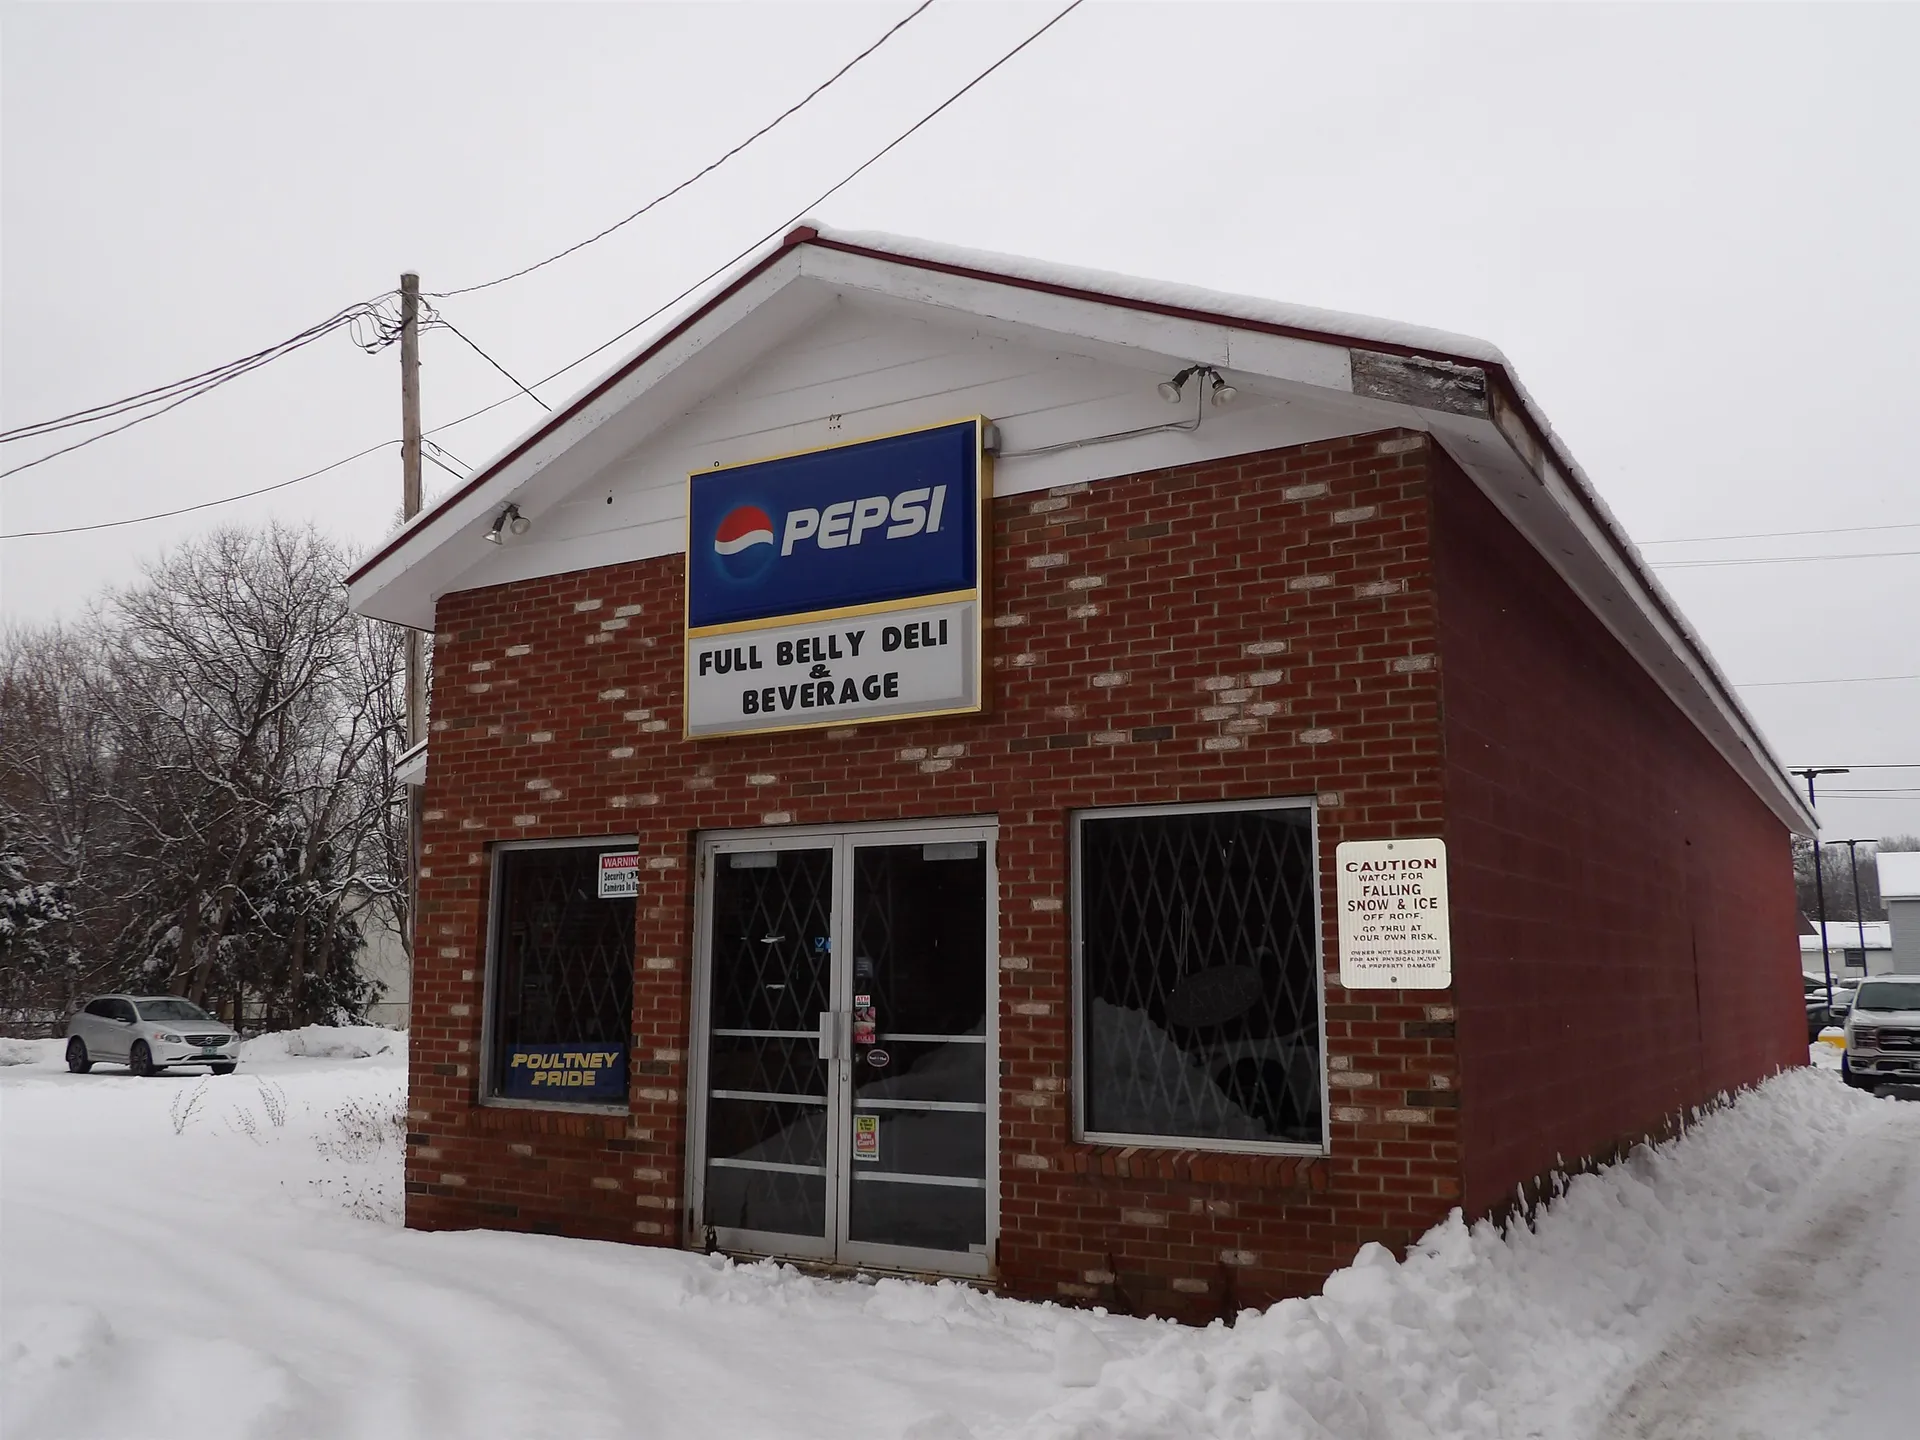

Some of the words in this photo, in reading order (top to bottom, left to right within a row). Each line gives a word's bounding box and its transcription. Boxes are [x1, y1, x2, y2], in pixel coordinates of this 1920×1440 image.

[781, 485, 947, 557] PEPSI
[699, 645, 762, 676] FULL
[776, 630, 865, 666] BELLY
[882, 619, 948, 652] DELI
[809, 664, 831, 679] &
[743, 672, 899, 715] BEVERAGE
[1345, 858, 1437, 872] CAUTION
[604, 871, 625, 882] Security
[1358, 873, 1395, 882] WATCH
[1401, 872, 1423, 880] FOR
[1363, 884, 1421, 897] FALLING
[1348, 899, 1389, 912] SNOW
[1397, 899, 1406, 910] &
[1414, 898, 1438, 910] ICE
[1363, 913, 1384, 921] OFF
[511, 1052, 619, 1069] POULTNEY
[531, 1071, 596, 1086] PRIDE
